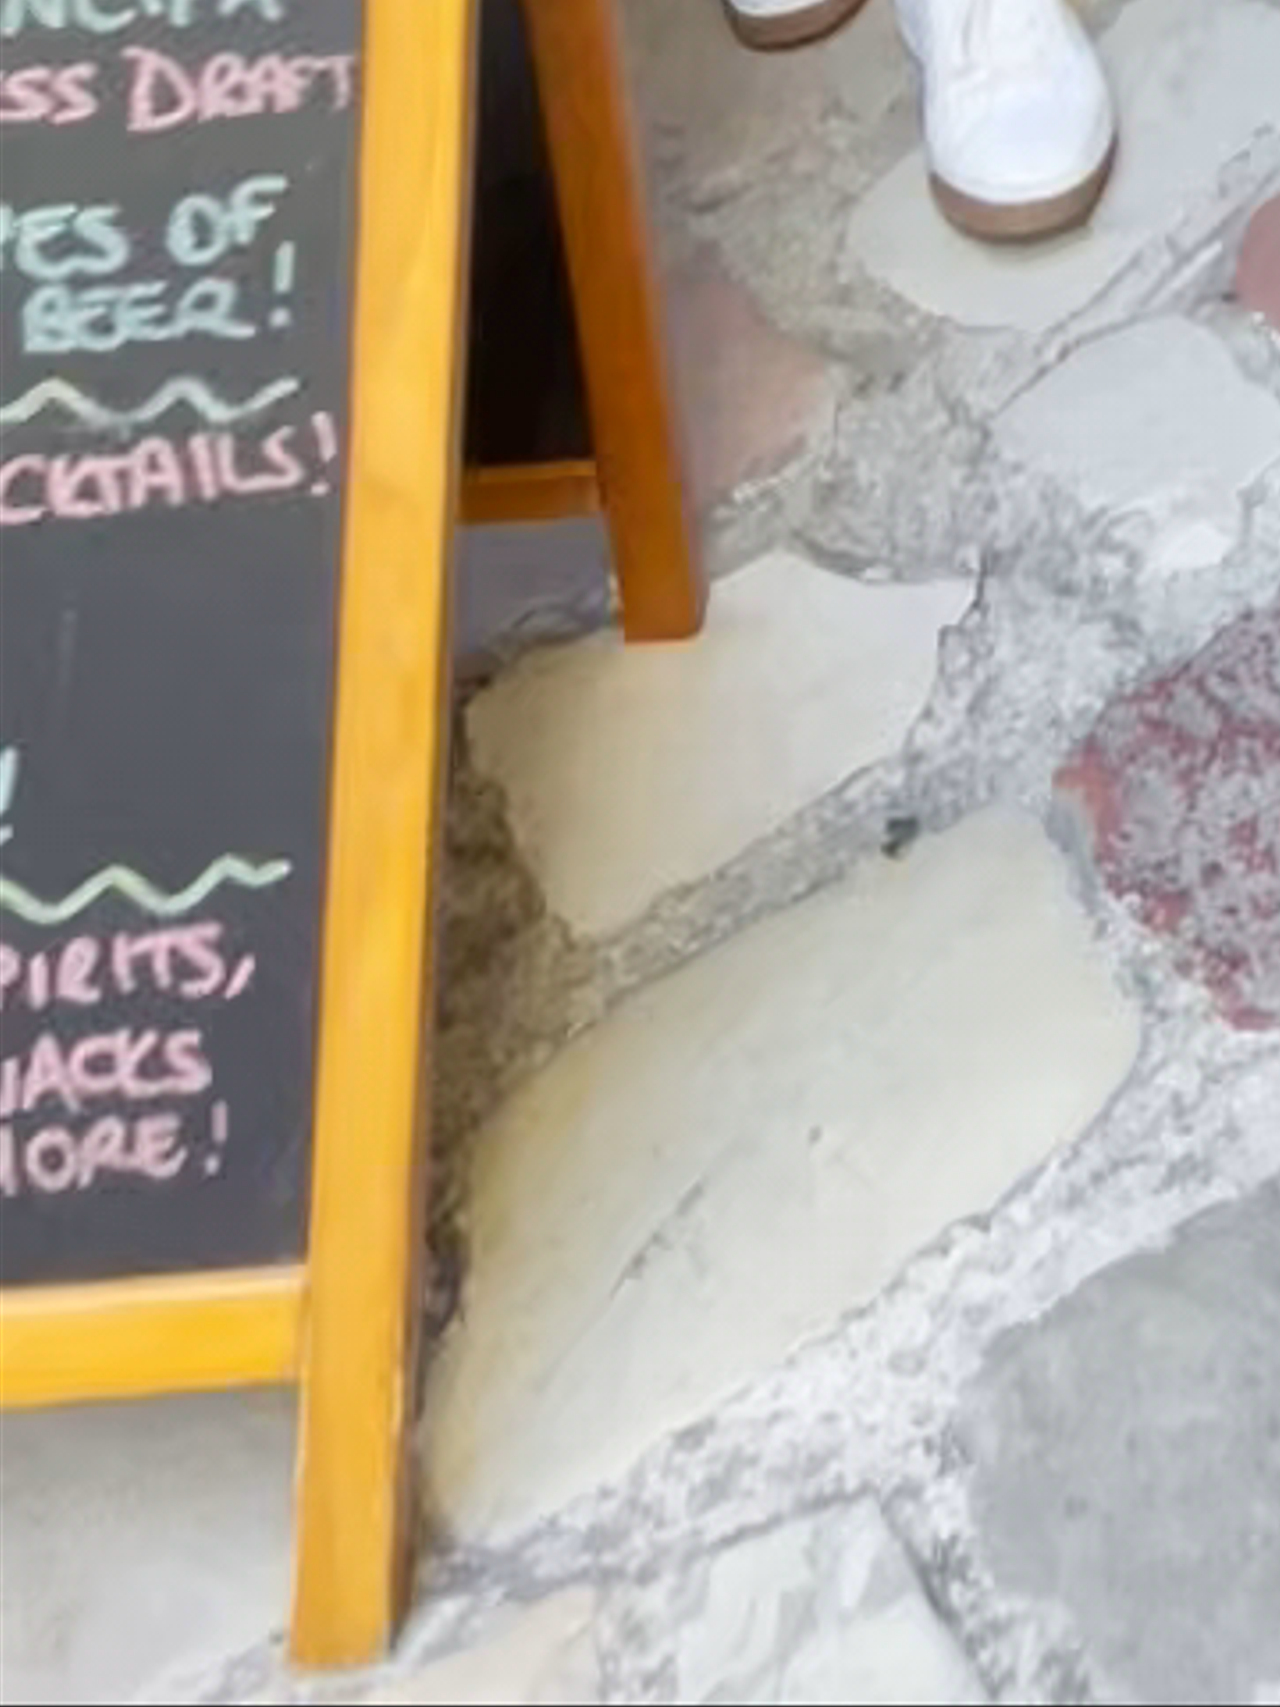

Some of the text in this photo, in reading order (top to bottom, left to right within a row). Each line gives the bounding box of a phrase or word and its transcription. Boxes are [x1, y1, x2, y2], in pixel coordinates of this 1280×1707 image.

[121, 47, 355, 132] DRAFT
[166, 175, 288, 265] OF
[22, 242, 295, 353] BEER!
[0, 1101, 228, 1198] ORE!
